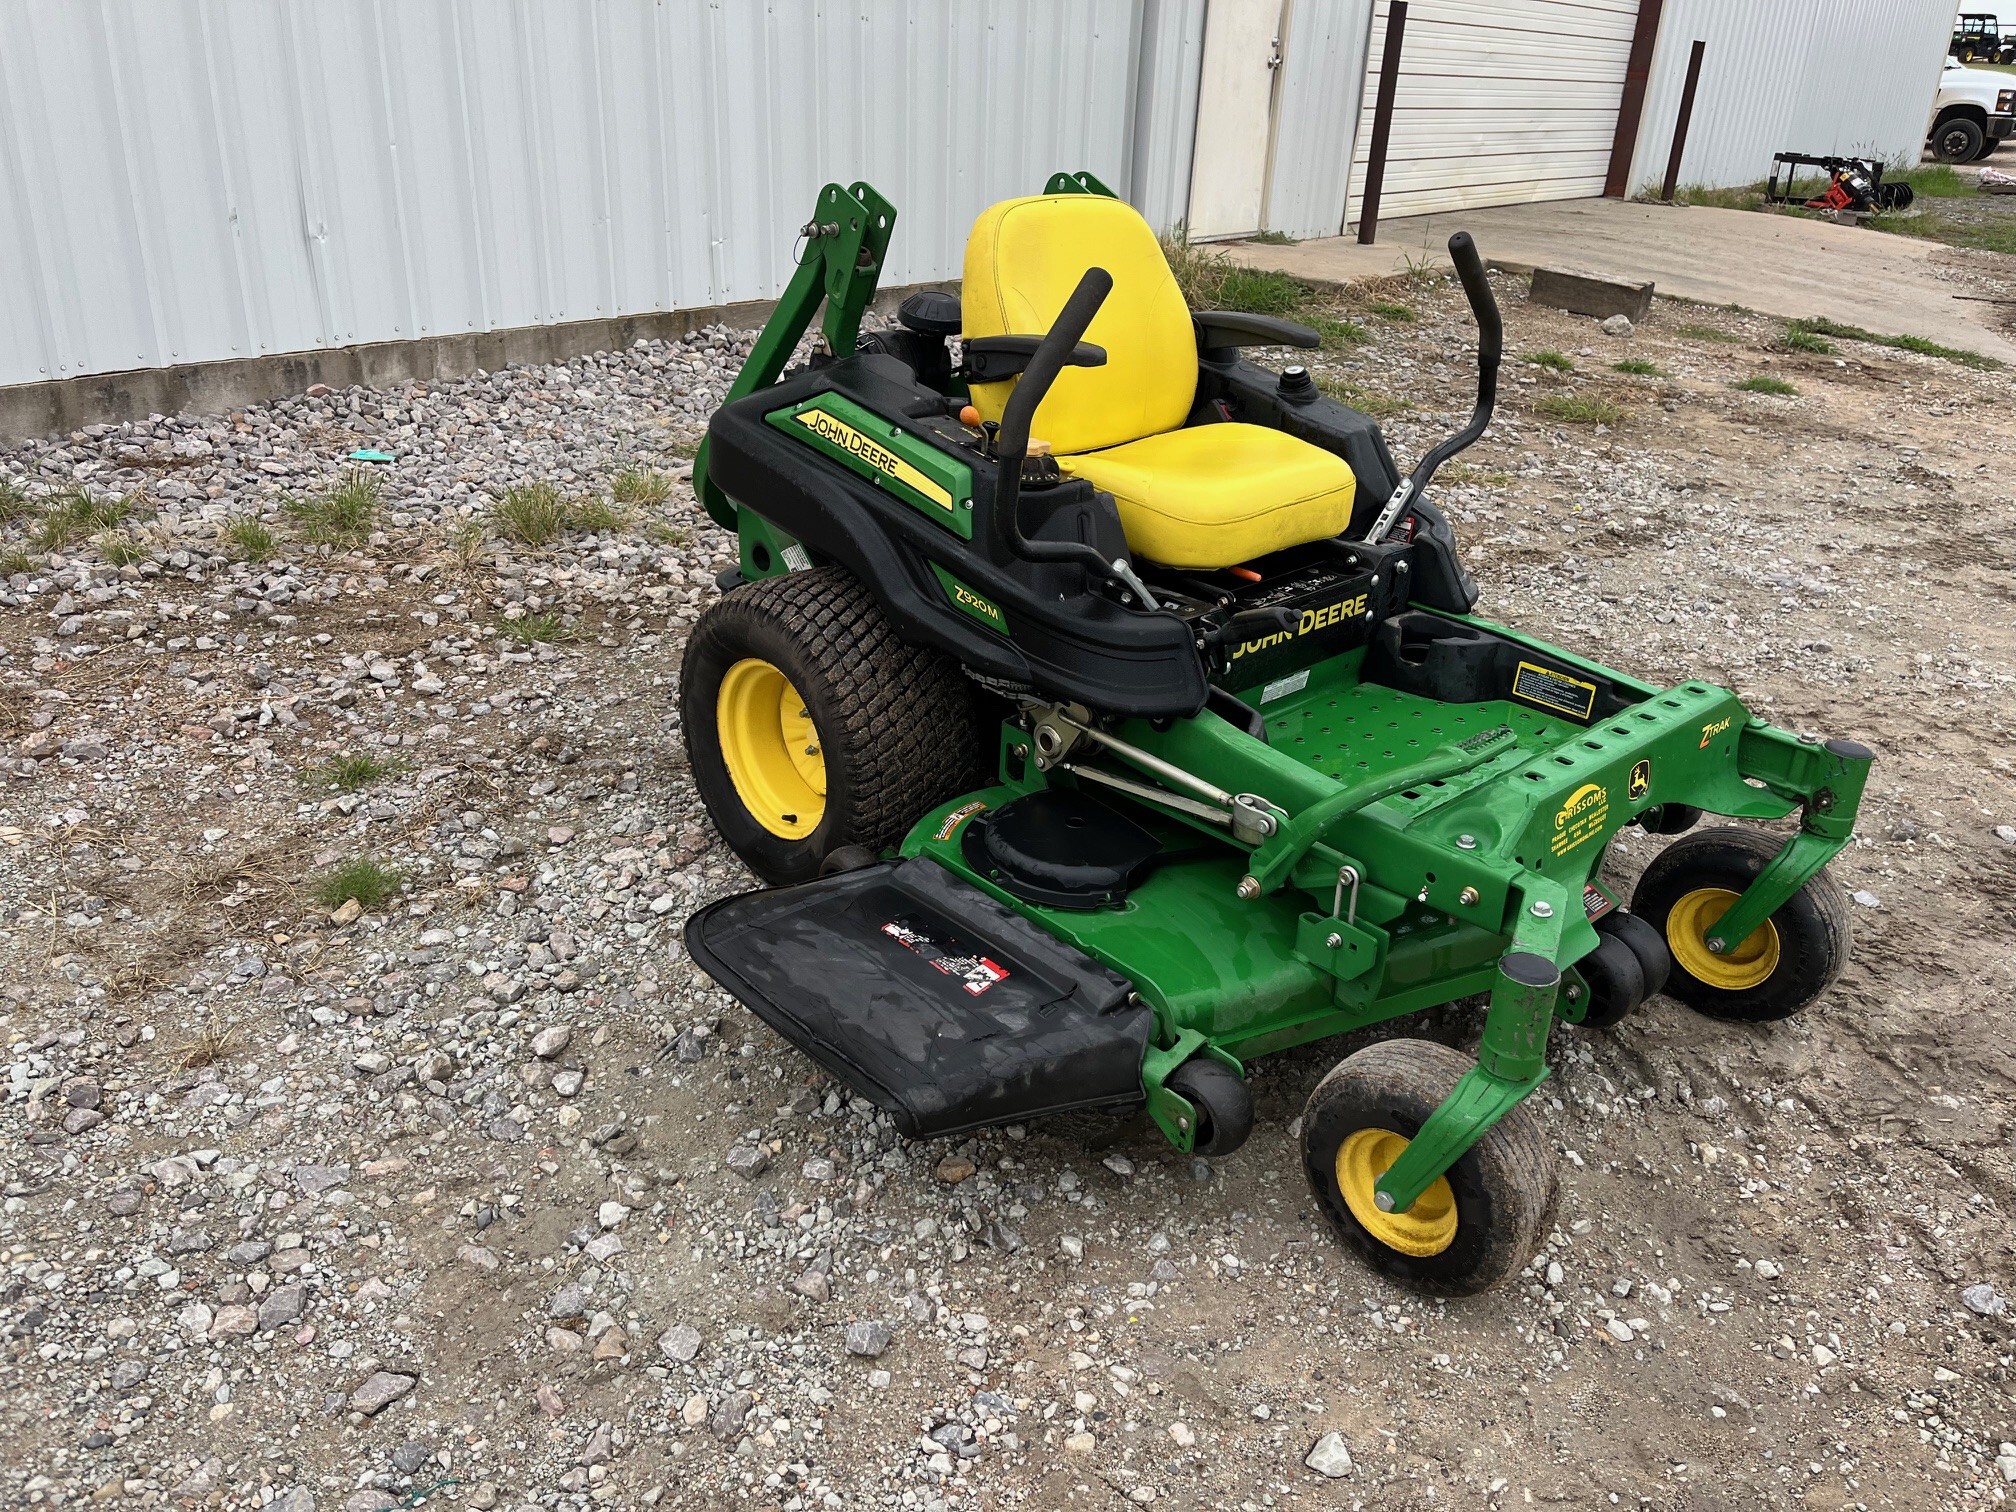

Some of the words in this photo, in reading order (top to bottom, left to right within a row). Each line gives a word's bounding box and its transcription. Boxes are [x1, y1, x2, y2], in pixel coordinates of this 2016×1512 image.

[809, 413, 848, 446] JOHN
[850, 434, 898, 475] DEERE
[954, 585, 998, 620] Z920M
[1299, 594, 1368, 636] DEERE
